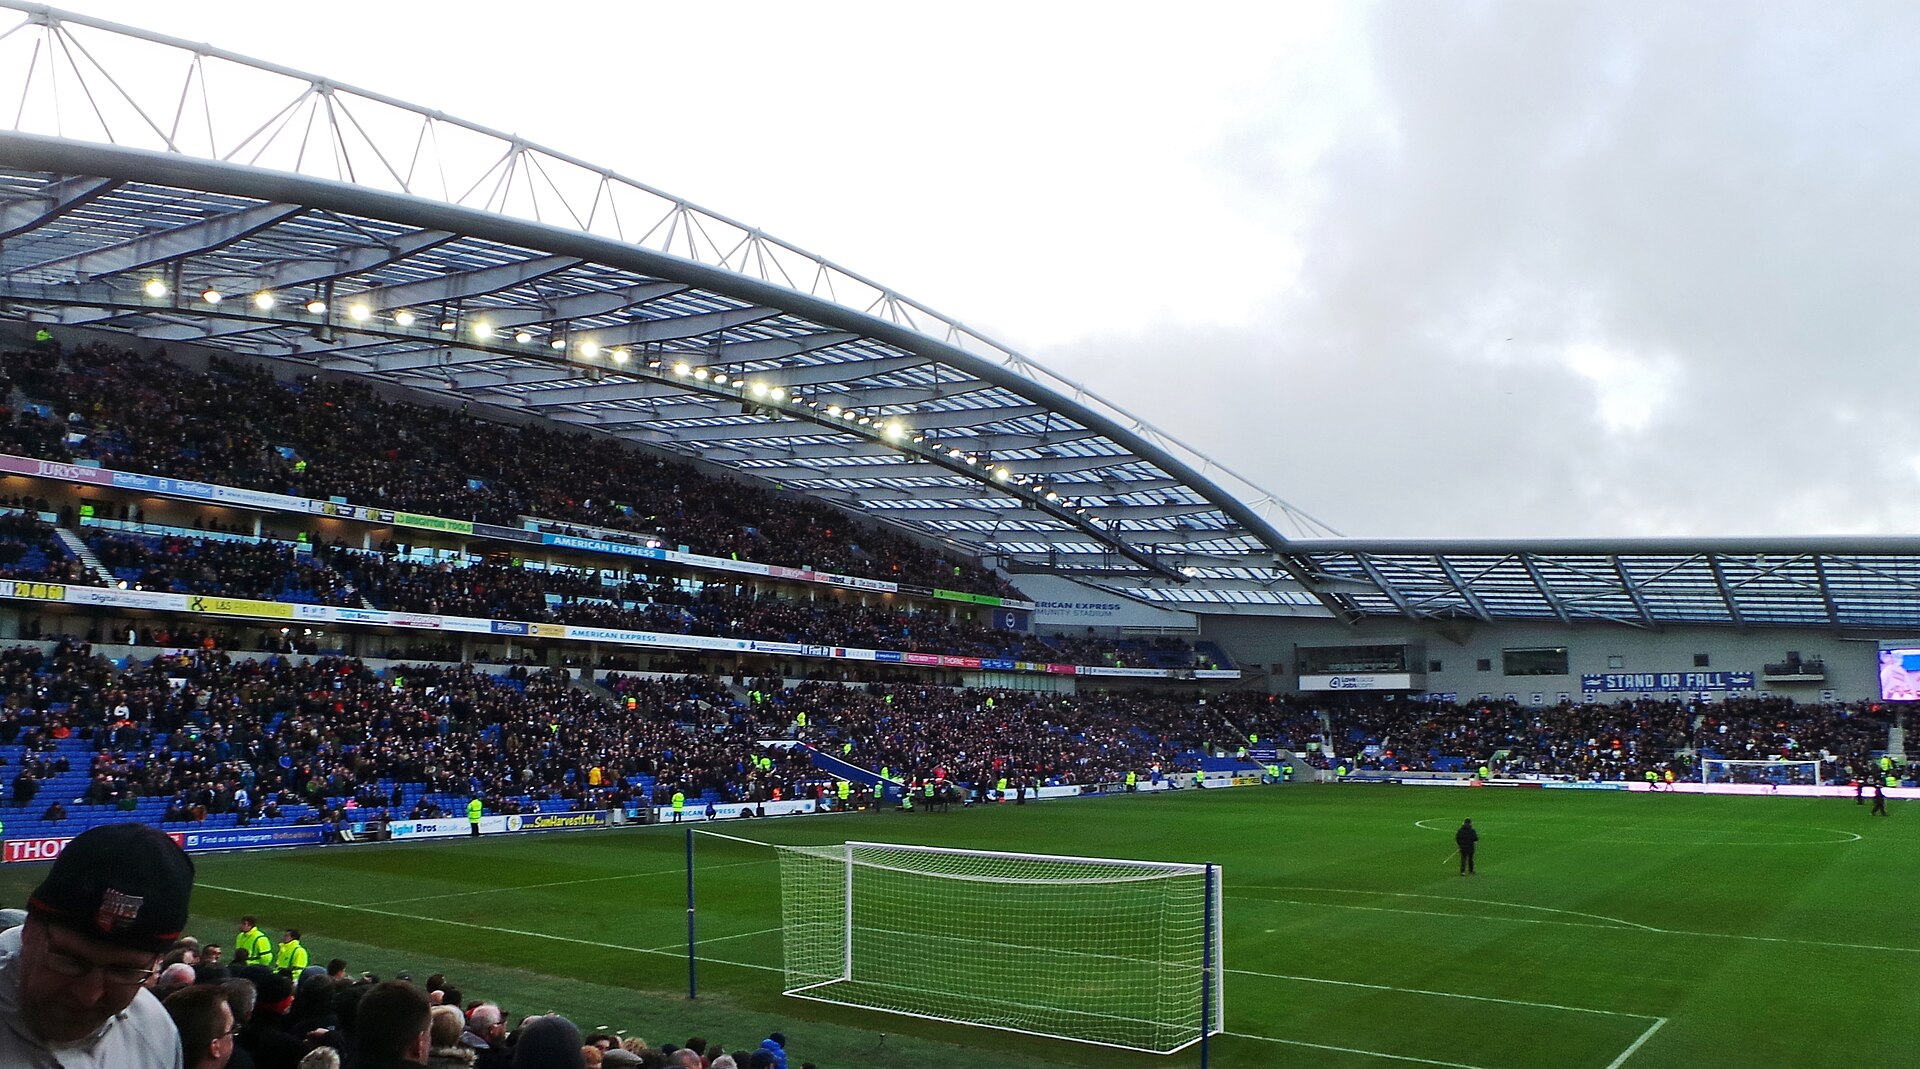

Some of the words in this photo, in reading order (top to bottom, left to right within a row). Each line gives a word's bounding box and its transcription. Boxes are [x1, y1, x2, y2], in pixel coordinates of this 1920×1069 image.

[36, 461, 80, 479] JURYS
[553, 537, 609, 552] AMERICAN
[612, 545, 655, 558] EXPRESS
[1035, 601, 1072, 609] ERICAN
[571, 629, 617, 640] AMERICAN
[620, 633, 657, 642] EXPRESS
[1606, 674, 1654, 688] STAND
[1661, 674, 1680, 688] OR
[1686, 673, 1726, 687] FALL
[665, 810, 703, 819] AMRICAN
[201, 836, 217, 844] Find
[238, 834, 272, 843] Instagram
